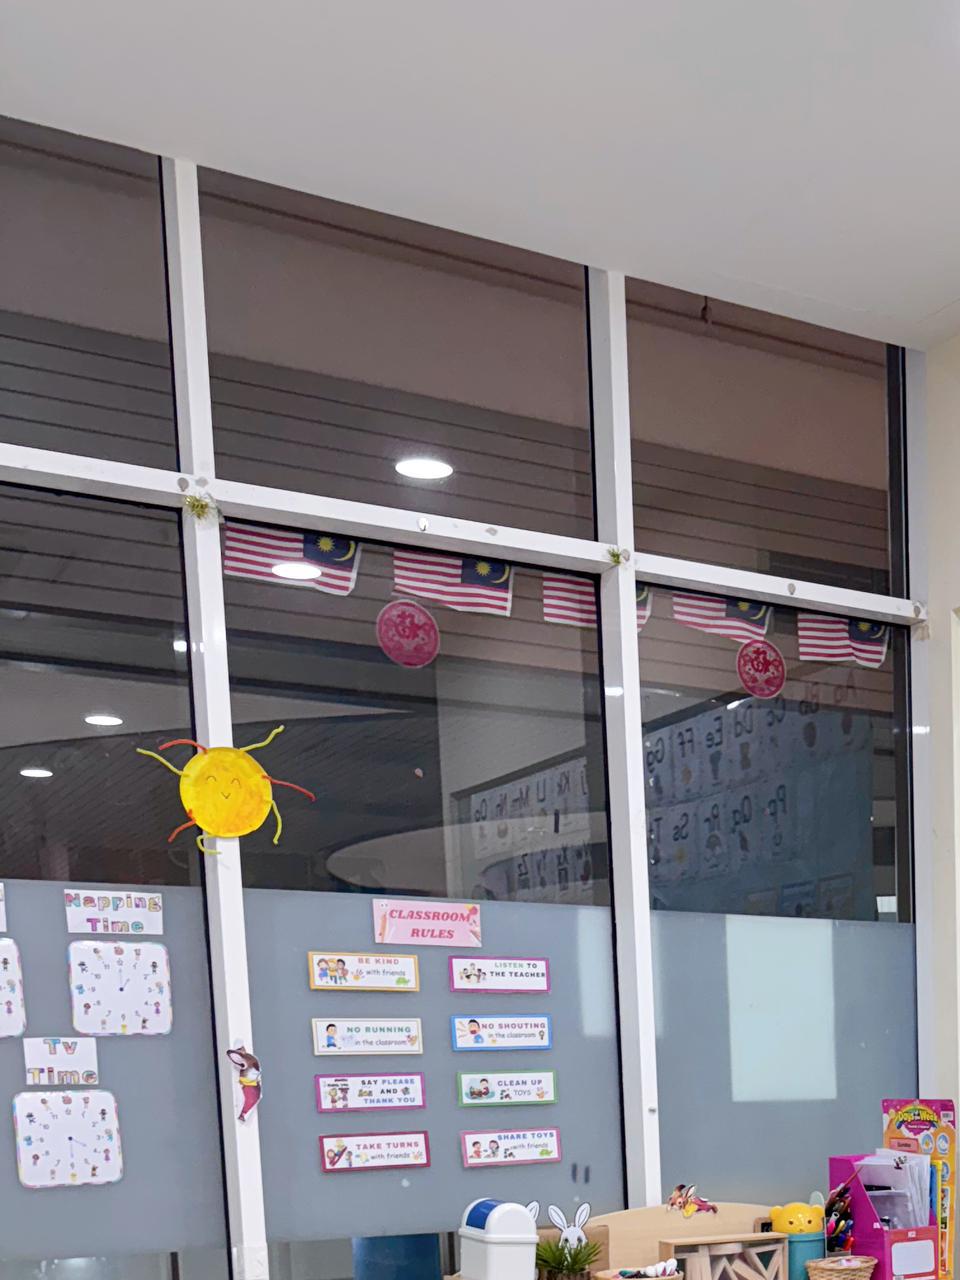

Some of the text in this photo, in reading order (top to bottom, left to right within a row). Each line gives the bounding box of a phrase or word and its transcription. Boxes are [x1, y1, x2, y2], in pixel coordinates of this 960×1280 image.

[64, 892, 162, 912] Napping
[389, 908, 471, 923] CLASSROOM
[86, 917, 144, 933] Time
[410, 928, 454, 940] RULES
[375, 957, 400, 966] KIND
[494, 962, 525, 970] LISTEN
[508, 971, 546, 979] TEACHER
[346, 1026, 412, 1034] NO RUNNING
[481, 1022, 546, 1031] NO SHOUTING
[43, 1039, 78, 1055] Tv
[27, 1067, 98, 1085] Time
[381, 1078, 415, 1086] PLEASE
[497, 1079, 528, 1087] CLEAN
[514, 1089, 531, 1097] TOYS
[364, 1096, 416, 1105] THANK YOU
[497, 1131, 555, 1141] SHARE TOYS
[355, 1140, 419, 1151] TAKE TURNS
